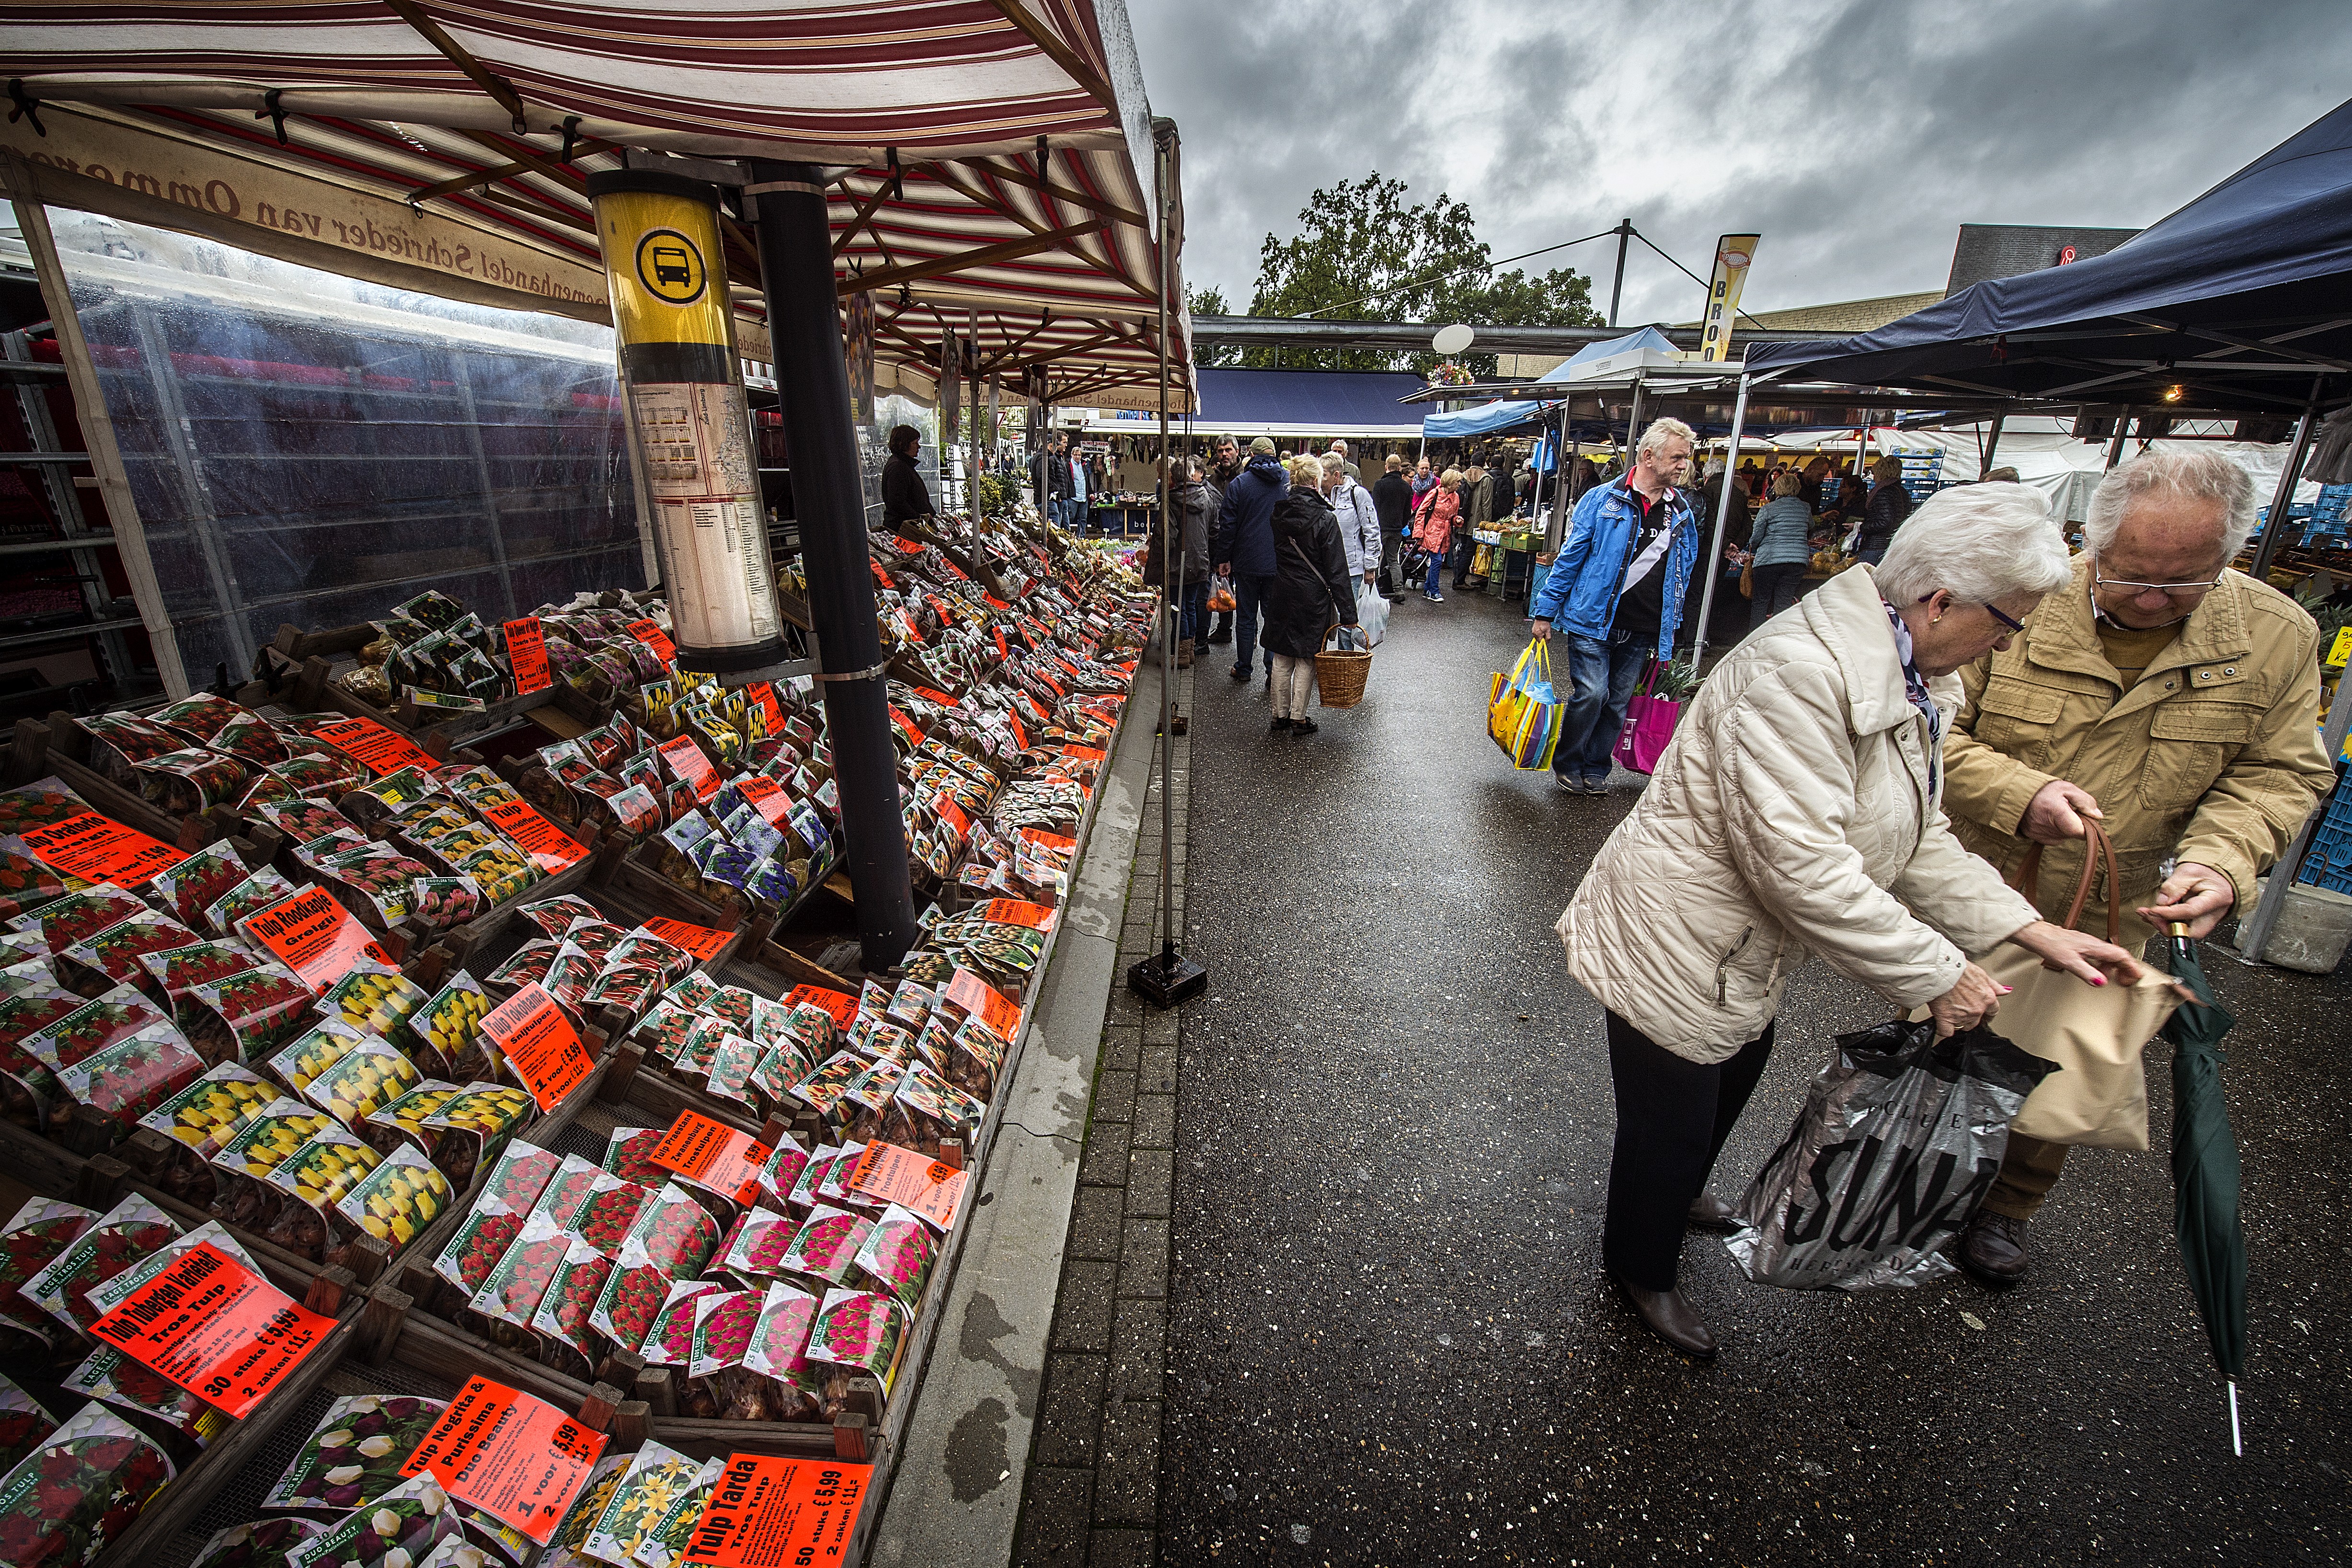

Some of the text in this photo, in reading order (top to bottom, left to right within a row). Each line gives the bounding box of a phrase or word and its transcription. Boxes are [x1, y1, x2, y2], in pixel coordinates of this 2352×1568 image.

[700, 389, 710, 425] Zuid-Limburg
[321, 722, 363, 736] Tulp
[336, 729, 387, 746] Viridiflora
[42, 817, 107, 840] Oratorio
[491, 805, 521, 819] Tulp
[505, 815, 540, 832] Viridiflora
[114, 862, 143, 873] voor
[132, 870, 159, 880] voor
[30, 907, 51, 918] TULIPA
[51, 894, 83, 909] ROODKAPJE
[252, 893, 332, 939] Tulp Roodkapje
[84, 937, 102, 948] TULIPA
[101, 923, 130, 939] ROODKAPJE
[227, 971, 257, 981] ROODKAPJE
[27, 1002, 102, 1046] 30 TULIPA ROODKAPJE
[414, 987, 451, 1025] 25 YOKOHAMA
[485, 991, 546, 1037] Tulp Yokohama
[511, 1010, 551, 1044] Snijtulpen
[64, 1039, 137, 1079] 30 TULIPA ROODKAPJE
[159, 1098, 180, 1112] TULIPA
[178, 1079, 206, 1099] YOKOHAMA
[535, 1079, 547, 1092] 1
[548, 1065, 563, 1081] voor
[556, 1079, 571, 1093] voor
[654, 1114, 692, 1160] Tulp Praestans
[671, 1123, 705, 1162] Zwanenburg
[683, 1127, 716, 1169] Trostulpen
[728, 1165, 750, 1191] 1 voor
[862, 1146, 889, 1175] Toronto
[881, 1155, 901, 1192] Trostulpen
[343, 1163, 390, 1209] 25 YOKOHAMA
[927, 1187, 942, 1214] 1 voor
[439, 1211, 481, 1268] 30 TULIPA ZWANENBURG
[39, 1246, 93, 1293] LAGE TROS TULP
[43, 1265, 58, 1277] 30
[98, 1318, 144, 1343] Tulp
[121, 1283, 185, 1326] Tubergen
[148, 1284, 226, 1343] Tros Tulp
[159, 1285, 259, 1370] bloemen Botanische
[151, 1334, 187, 1365] Prachtige
[747, 1355, 756, 1364] 25
[204, 1376, 231, 1397] 30
[233, 1348, 267, 1378] stuks
[242, 1356, 291, 1398] 2 zakken
[407, 1383, 485, 1472] Tulp Negrita &
[441, 1402, 496, 1467] Purissima
[456, 1404, 518, 1482] Duo Beauty
[279, 1476, 290, 1485] 30
[281, 1457, 311, 1497] DUO BEAUTY
[517, 1501, 536, 1517] 1
[533, 1464, 559, 1496] voor
[544, 1473, 577, 1517] 2 voor
[598, 1488, 628, 1531] TULIPA TARDA
[652, 1499, 686, 1538] TULIPA TARDA
[688, 1462, 757, 1557] Tulp Tarda
[731, 1477, 769, 1549] Tros Tulp
[305, 1526, 356, 1560] DUO BEAUTY
[314, 1532, 329, 1544] 30
[590, 1537, 600, 1549] 50
[641, 1544, 652, 1555] 50
[740, 1548, 750, 1564] Mooie
[749, 1498, 771, 1545] laagblijvende
[746, 1535, 758, 1565] Meerdere
[795, 1548, 815, 1566] 50
[813, 1511, 828, 1543] stuks
[827, 1510, 851, 1556] 2 zakken
